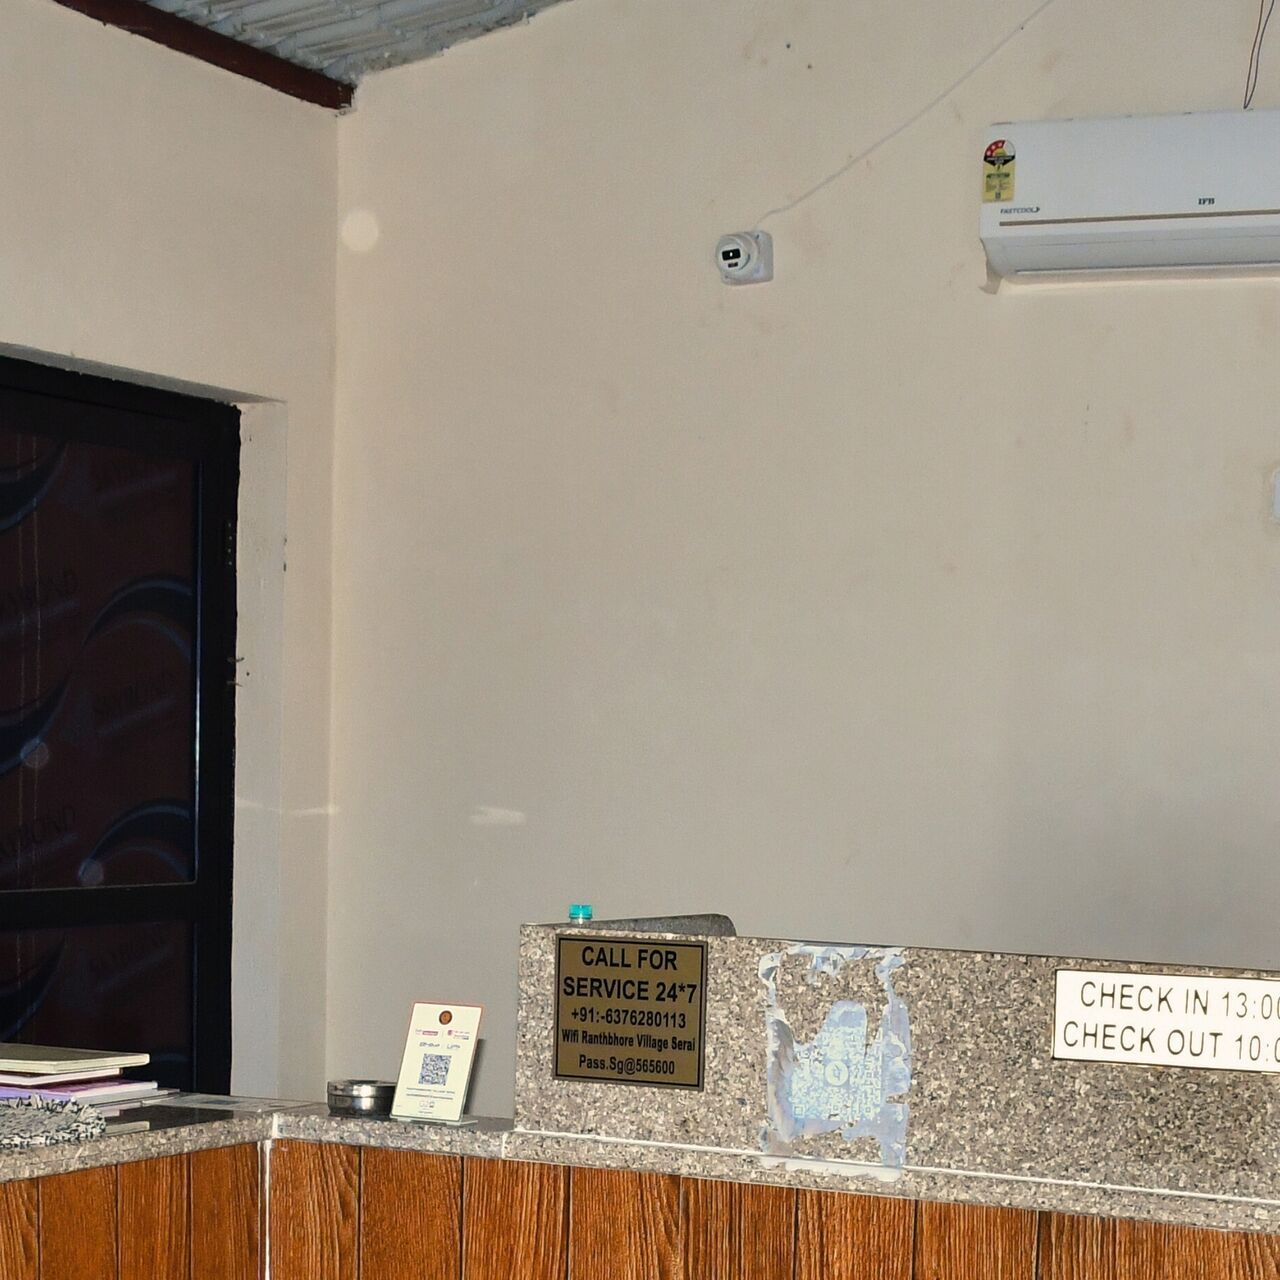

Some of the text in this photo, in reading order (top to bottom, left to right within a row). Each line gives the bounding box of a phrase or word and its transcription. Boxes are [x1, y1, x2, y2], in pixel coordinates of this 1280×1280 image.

[582, 946, 678, 971] CALL FOR
[563, 976, 649, 1000] SERVICE
[1080, 981, 1174, 1013] CHECK
[1185, 988, 1209, 1016] IN
[572, 1007, 686, 1028] +91:-6376280113
[561, 1028, 695, 1052] Wifi Ranthbhore Village Serai
[1063, 1020, 1155, 1053] CHECK
[1167, 1028, 1223, 1058] OUT
